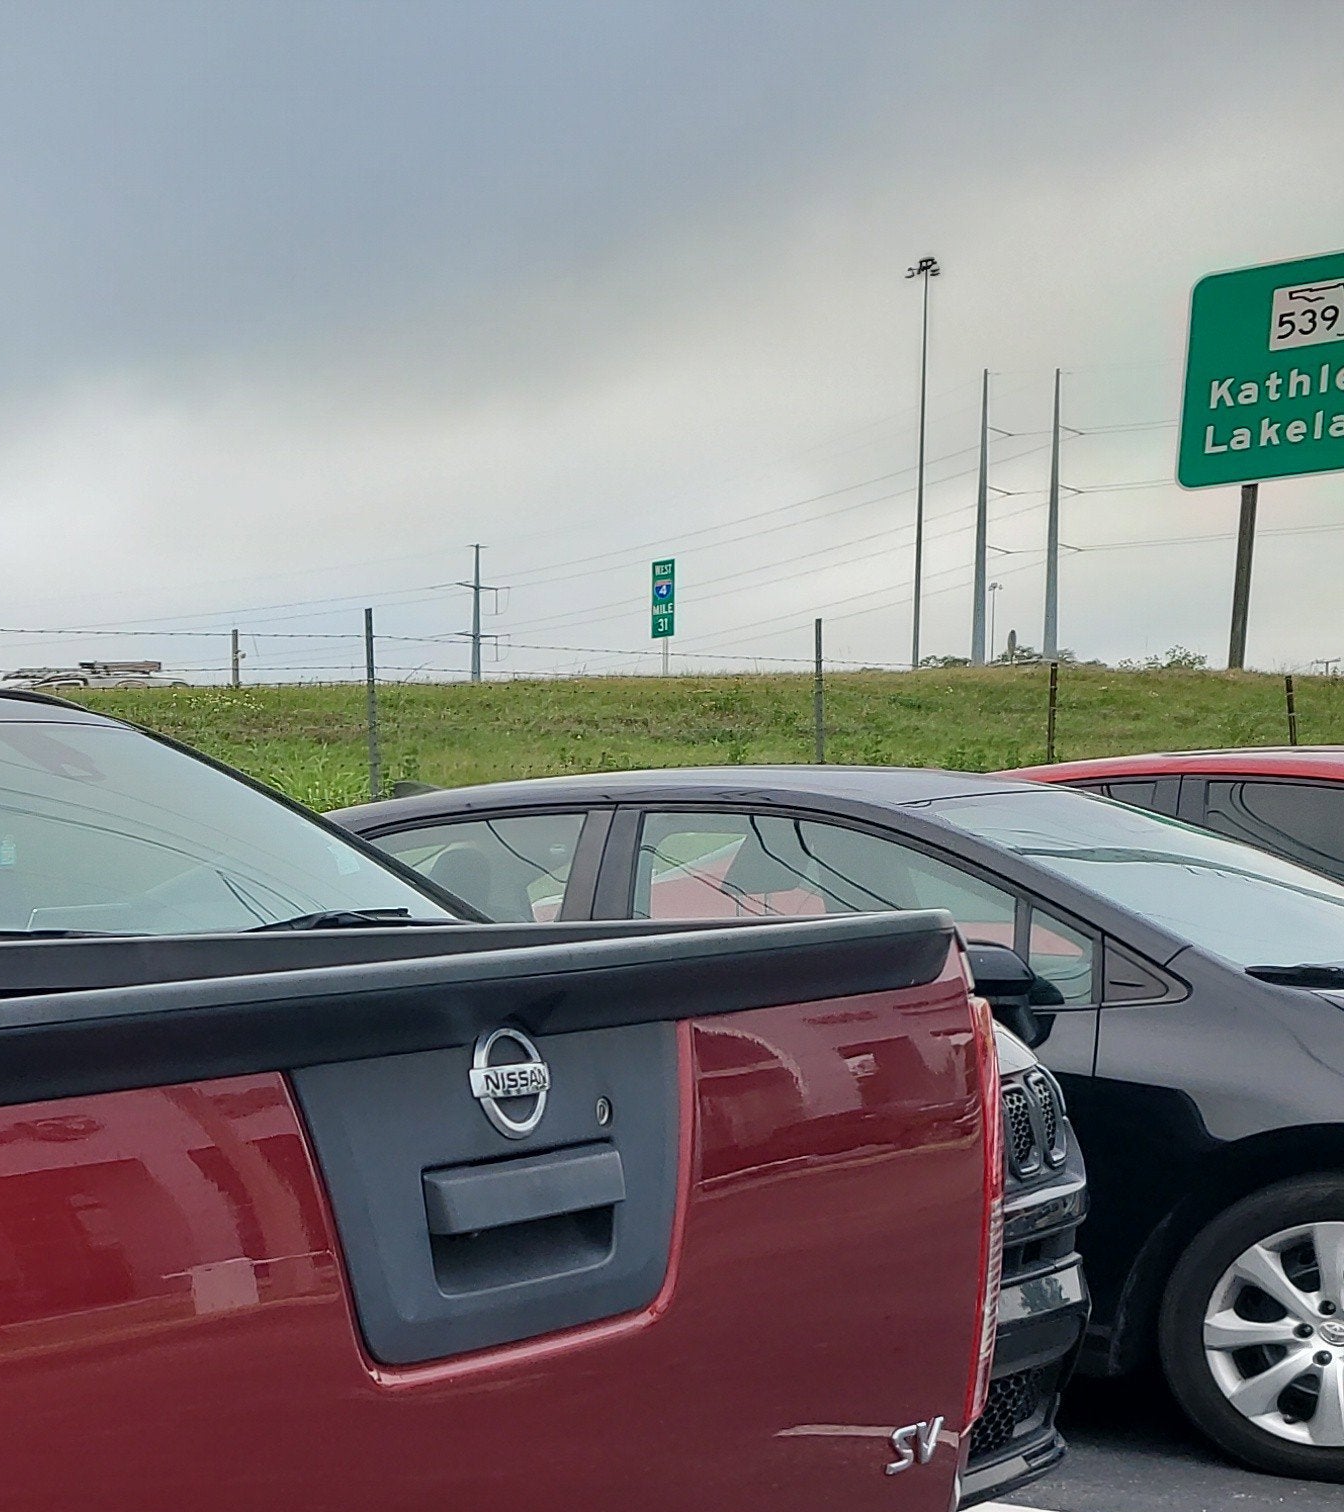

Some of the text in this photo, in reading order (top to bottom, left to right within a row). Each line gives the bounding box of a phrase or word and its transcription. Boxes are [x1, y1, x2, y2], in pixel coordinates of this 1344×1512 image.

[1276, 304, 1340, 340] 539
[1204, 411, 1344, 454] Lakela
[655, 564, 672, 575] WEST
[659, 584, 667, 595] 4
[653, 602, 673, 615] MILE
[657, 617, 668, 631] 31
[483, 1066, 548, 1091] NISSAN
[885, 1415, 944, 1475] SV
